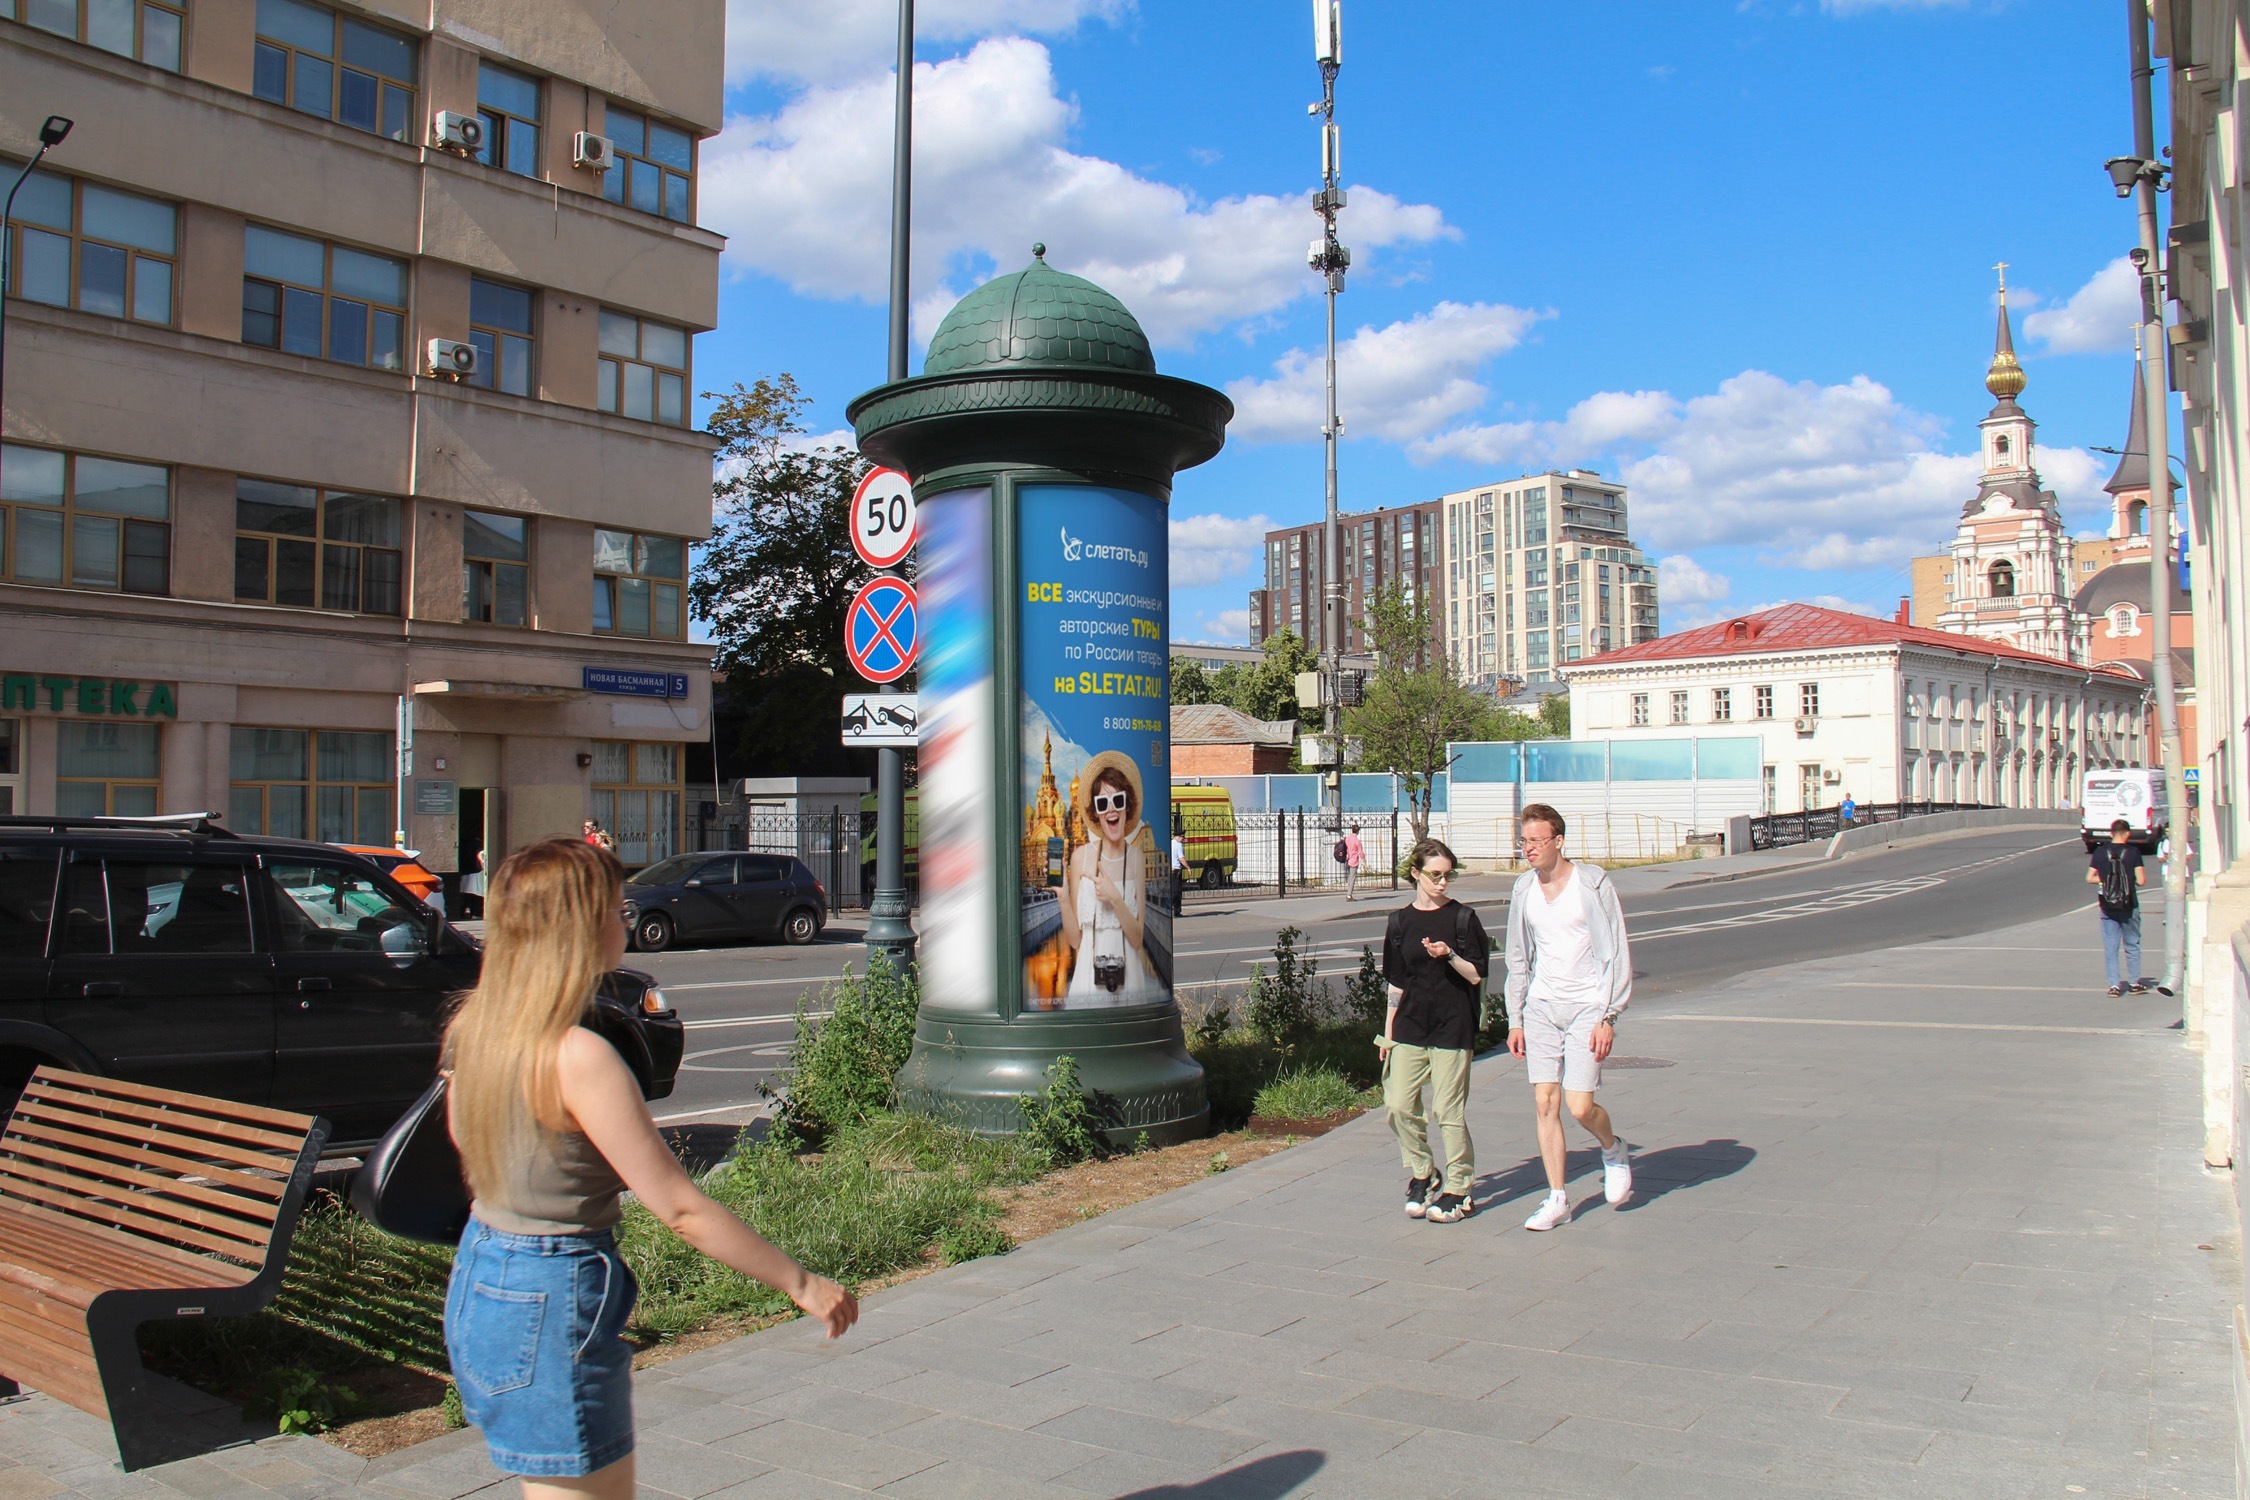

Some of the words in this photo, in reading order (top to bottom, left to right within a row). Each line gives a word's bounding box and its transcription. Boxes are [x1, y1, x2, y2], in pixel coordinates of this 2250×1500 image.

[867, 494, 907, 536] 50
[1085, 544, 1149, 568] слетать.ру
[1027, 583, 1063, 602] ВСЕ
[1066, 589, 1156, 610] экскурсионные
[1157, 598, 1162, 612] и
[1059, 619, 1129, 638] авторские
[1131, 618, 1160, 640] ТУРЫ
[1065, 646, 1082, 660] по
[1085, 643, 1134, 662] России
[1136, 650, 1162, 669] теперь
[590, 673, 615, 683] НОВАЯ
[618, 675, 664, 687] БАСМАННАЯ
[675, 678, 683, 691] 5
[1054, 676, 1075, 693] на
[1079, 672, 1162, 699] SLETAT.RU!
[3, 675, 177, 718] ПТЕКА
[1103, 717, 1110, 729] 8
[1112, 717, 1131, 730] 800
